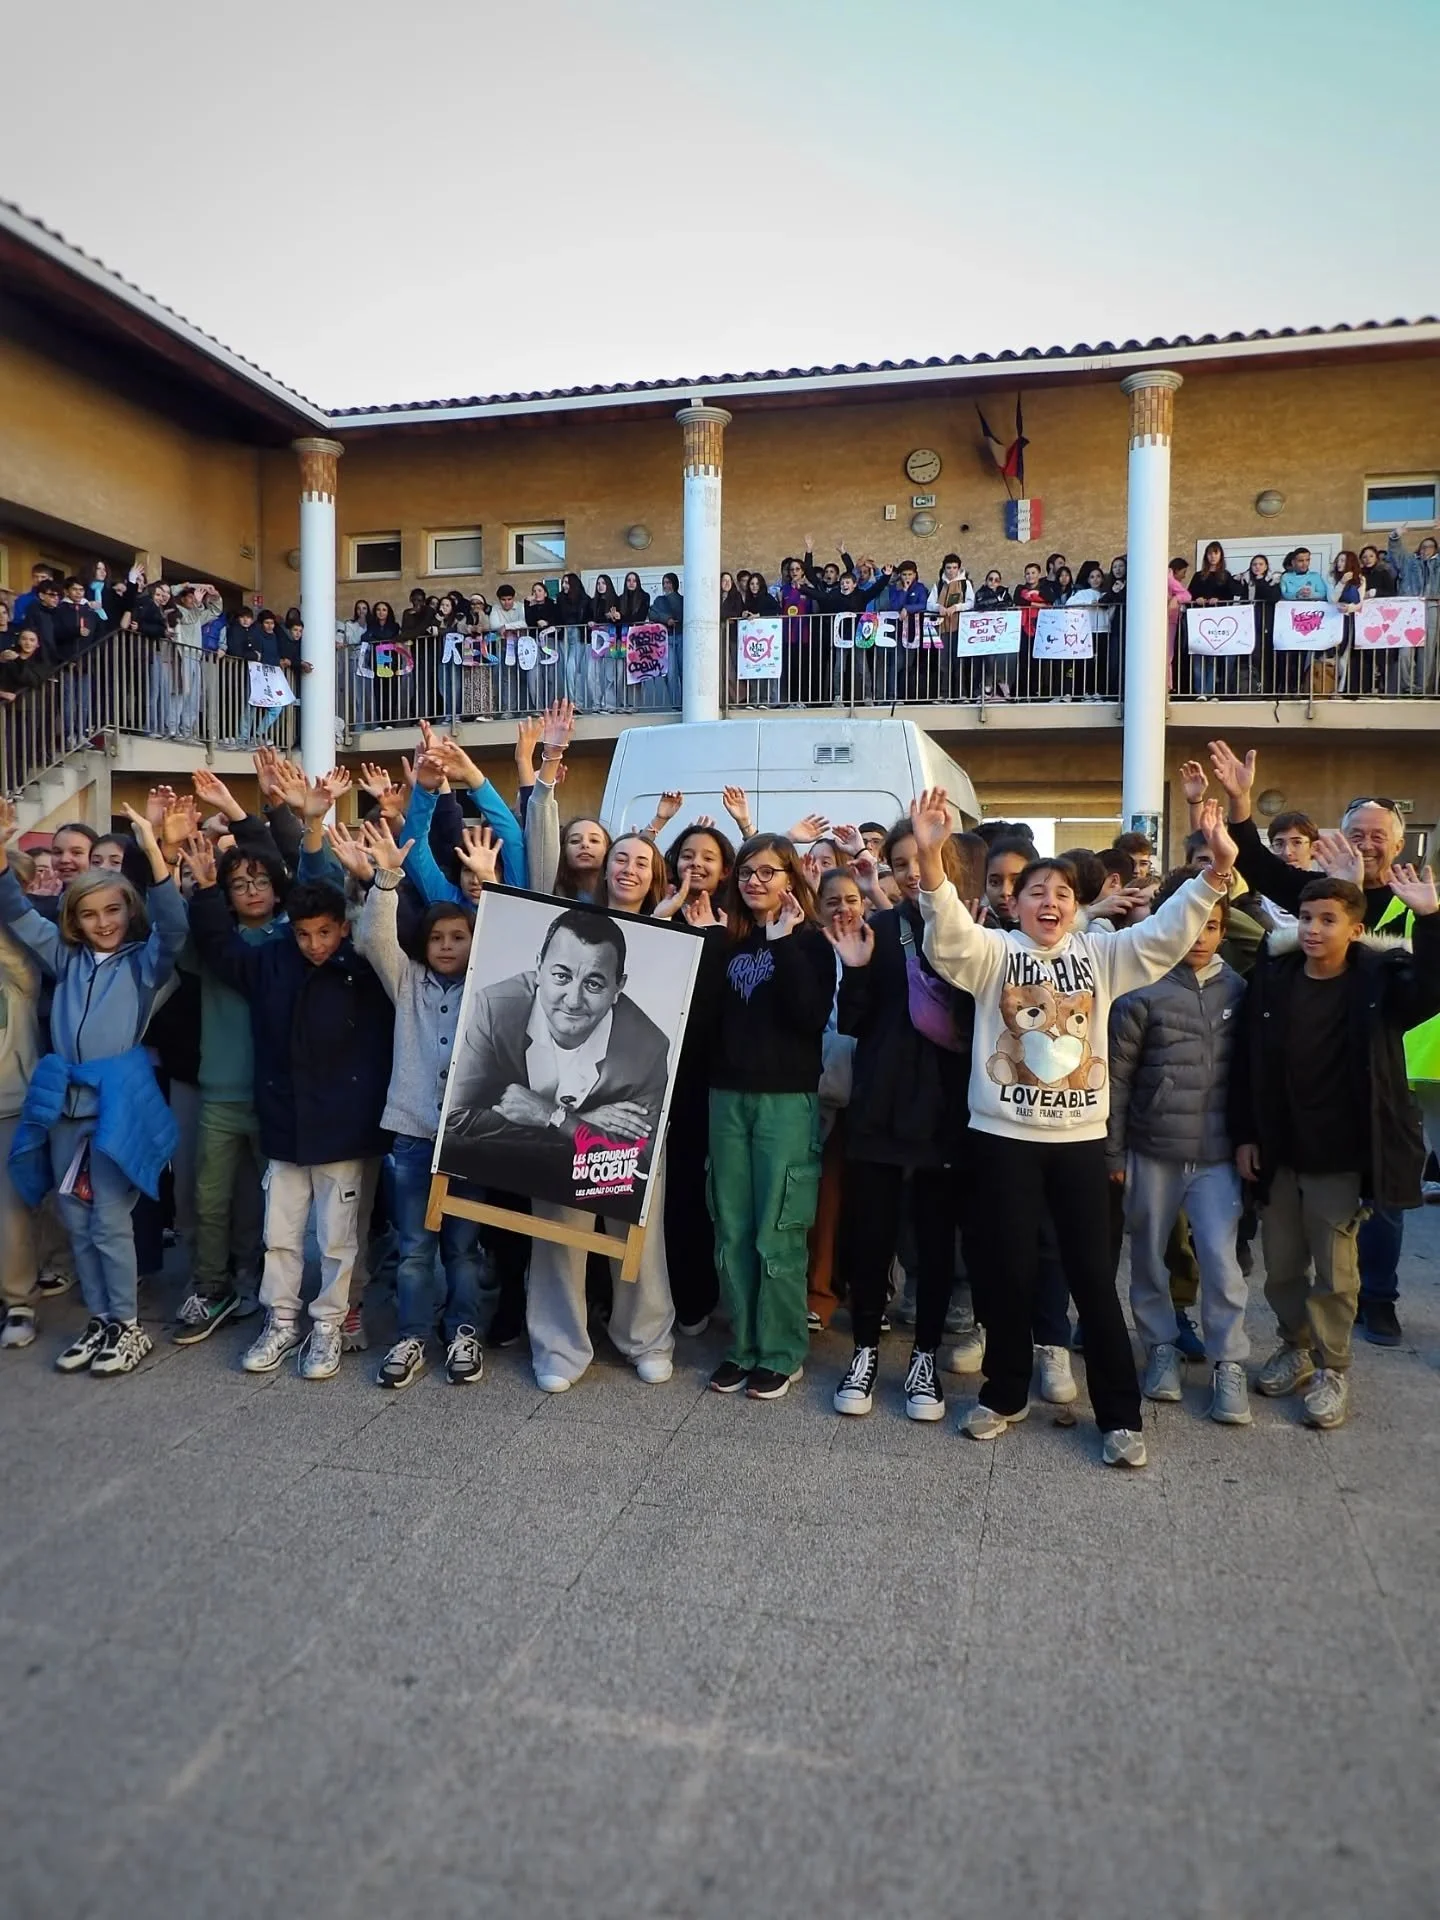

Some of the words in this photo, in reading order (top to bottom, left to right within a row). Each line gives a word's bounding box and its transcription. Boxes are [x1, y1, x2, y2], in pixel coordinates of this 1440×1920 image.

[834, 611, 944, 649] COEUR
[1000, 1084, 1097, 1108] LOVEABLE
[1016, 1106, 1033, 1117] PARIS
[1039, 1109, 1063, 1118] FRANCE
[573, 1154, 586, 1165] LES
[587, 1147, 640, 1164] RESTAURANTS
[572, 1166, 589, 1180] DU
